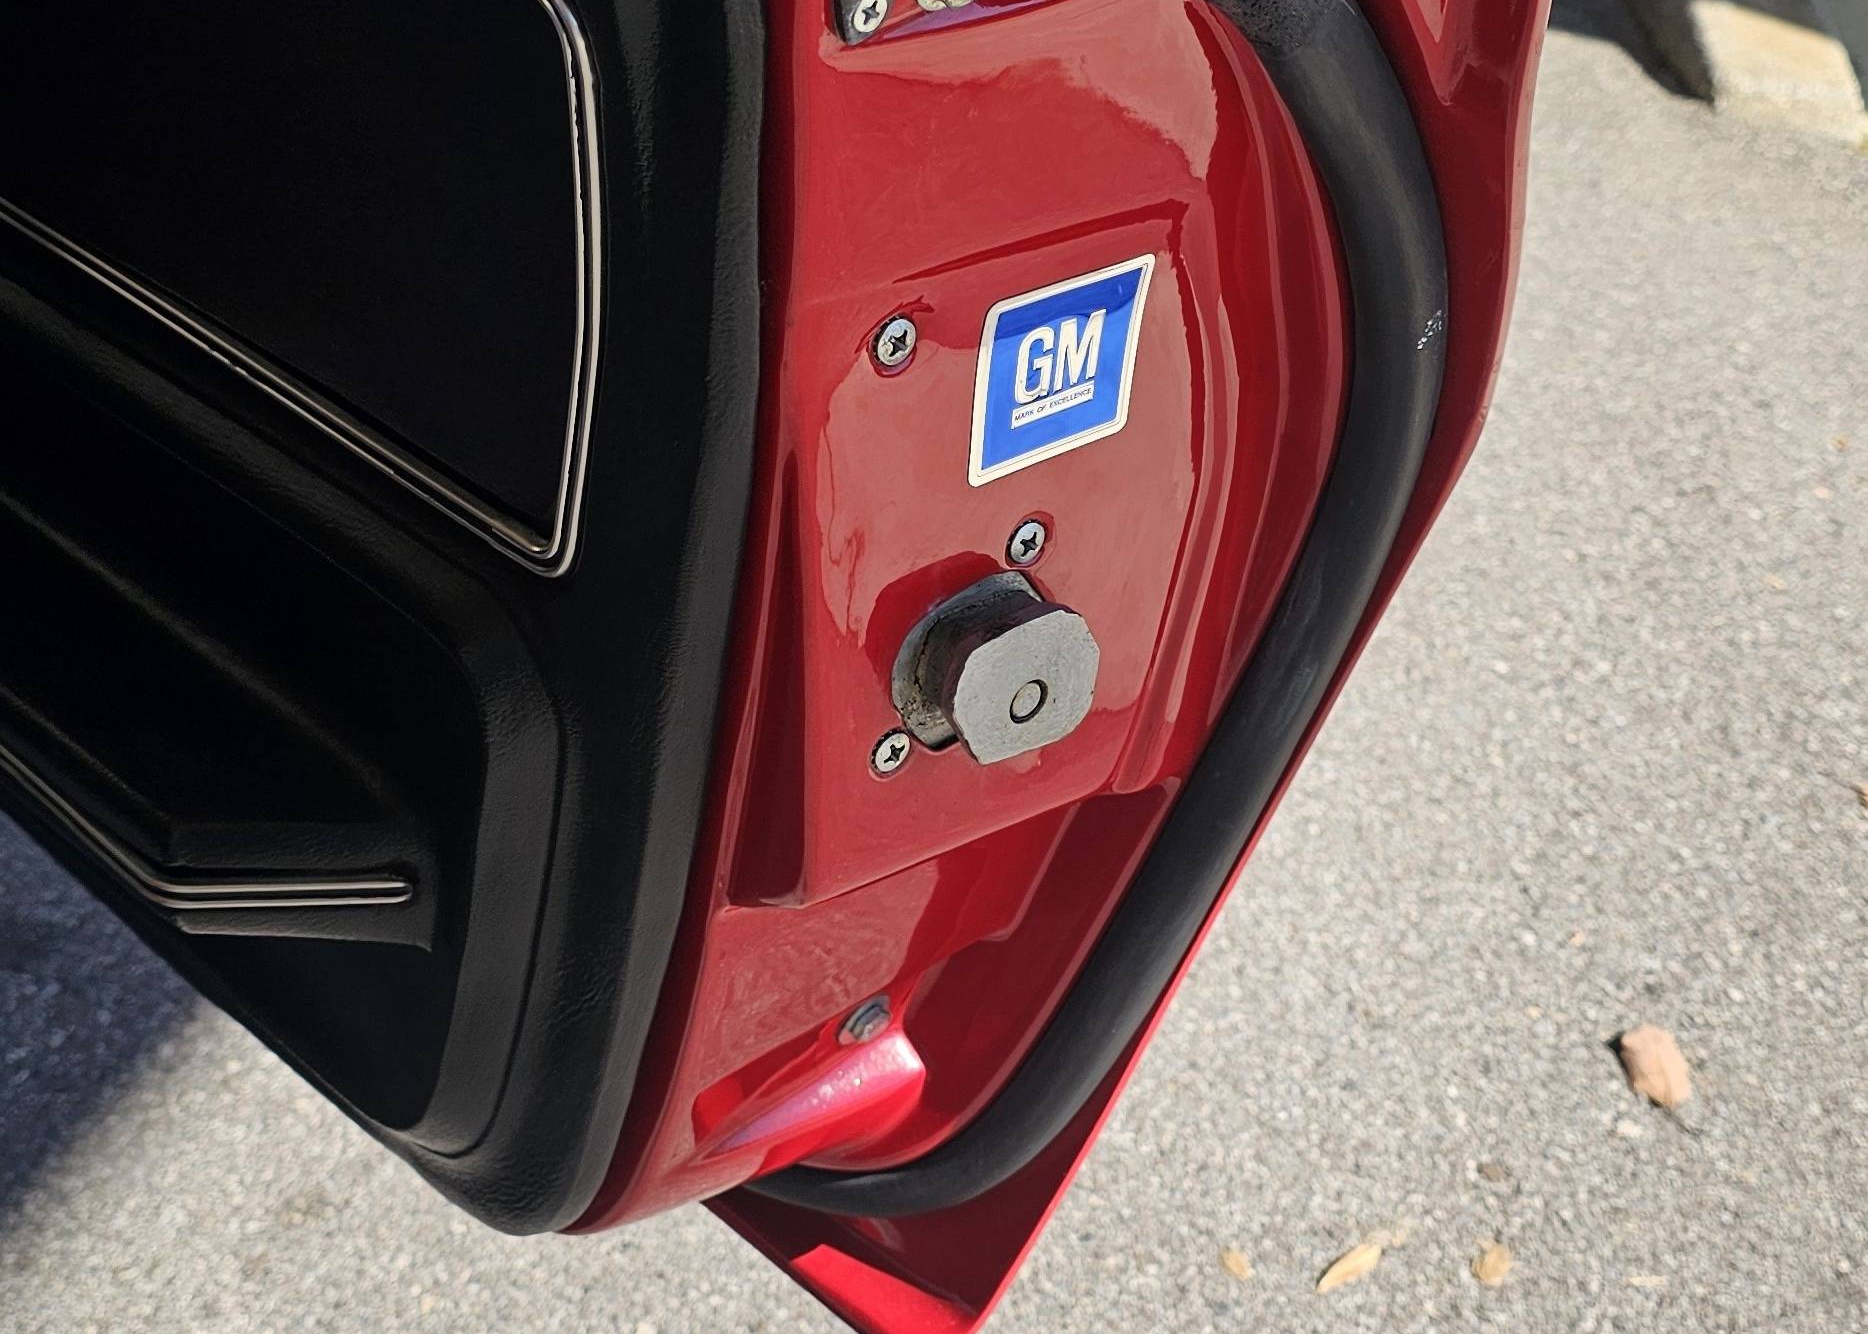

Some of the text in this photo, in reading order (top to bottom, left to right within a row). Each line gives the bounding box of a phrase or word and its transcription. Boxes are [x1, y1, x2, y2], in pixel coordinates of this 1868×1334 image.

[1014, 308, 1107, 405] GM
[1014, 387, 1092, 421] MARK OF EXCELLENCE
